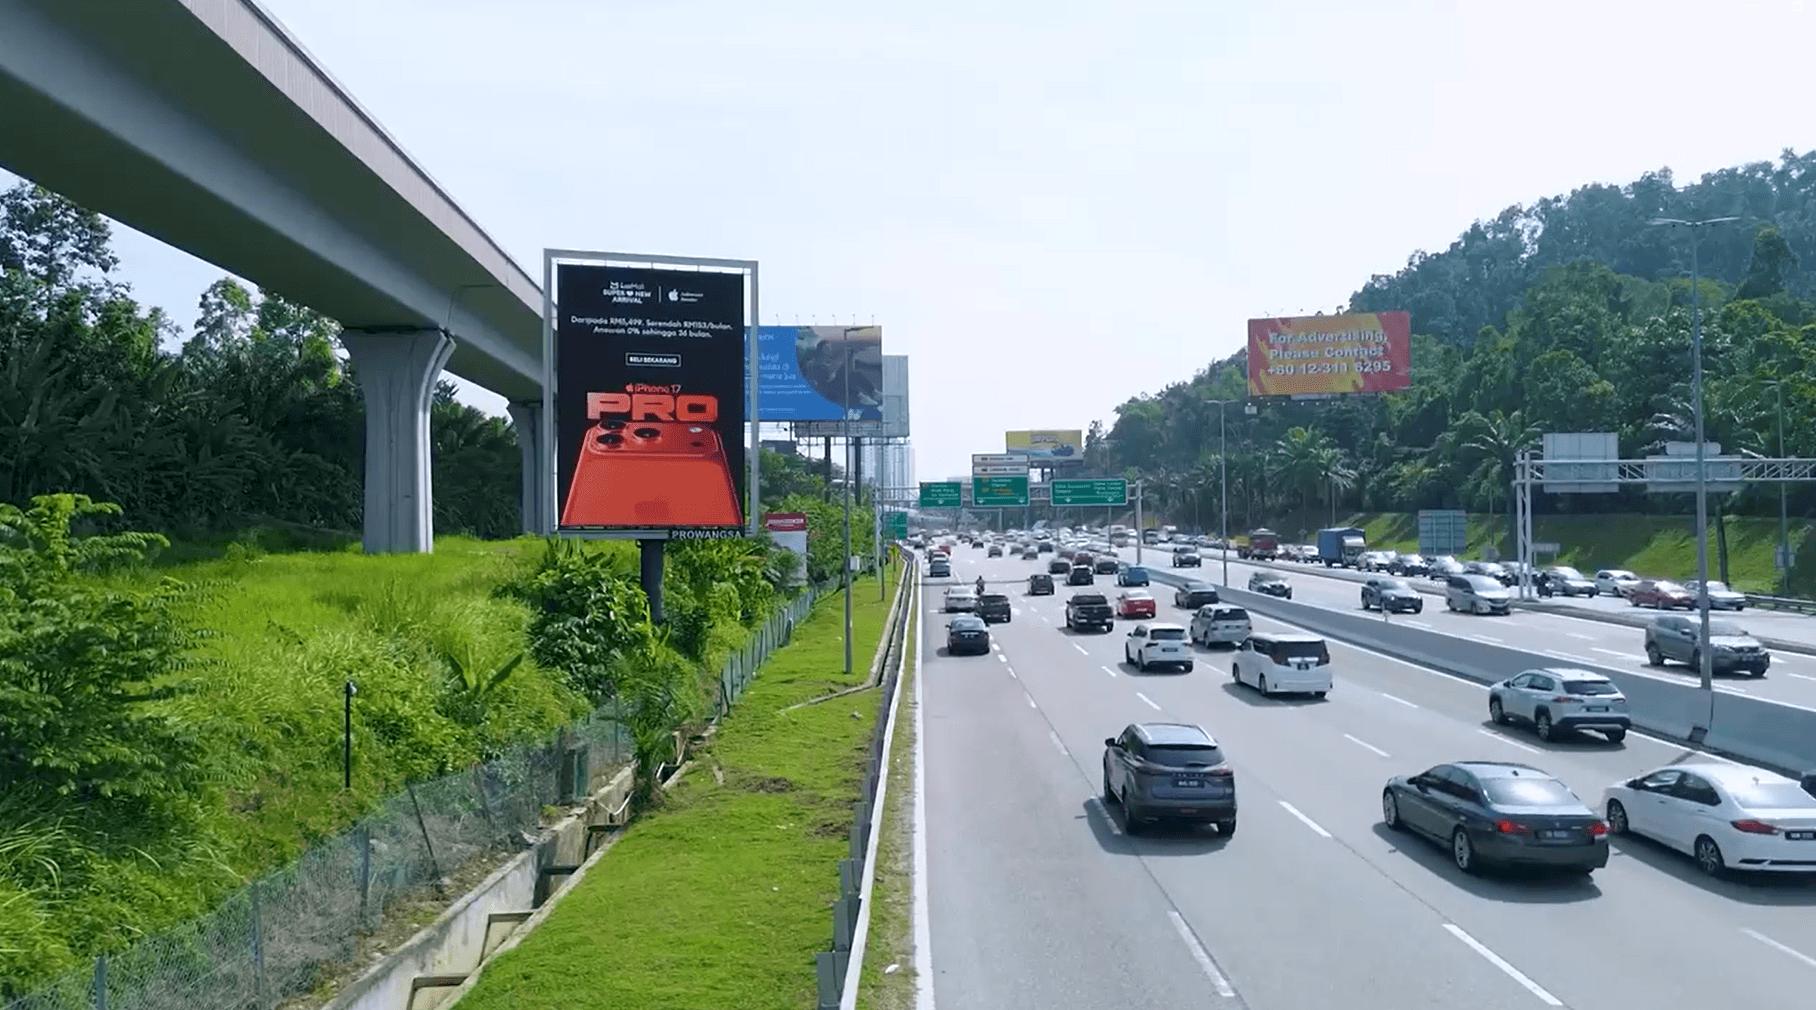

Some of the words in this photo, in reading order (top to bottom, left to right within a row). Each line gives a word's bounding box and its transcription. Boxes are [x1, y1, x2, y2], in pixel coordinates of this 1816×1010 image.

[635, 290, 652, 298] NEW
[611, 296, 643, 304] ARRIVAL
[627, 327, 641, 335] 0%
[1269, 332, 1293, 344] For
[1269, 348, 1319, 360] Please
[1324, 346, 1384, 358] Contact
[643, 356, 678, 364] SEKARANG
[634, 383, 670, 394] iPhone
[670, 383, 682, 394] 17
[587, 392, 719, 422] PRO
[671, 530, 742, 540] PROWANGSA
